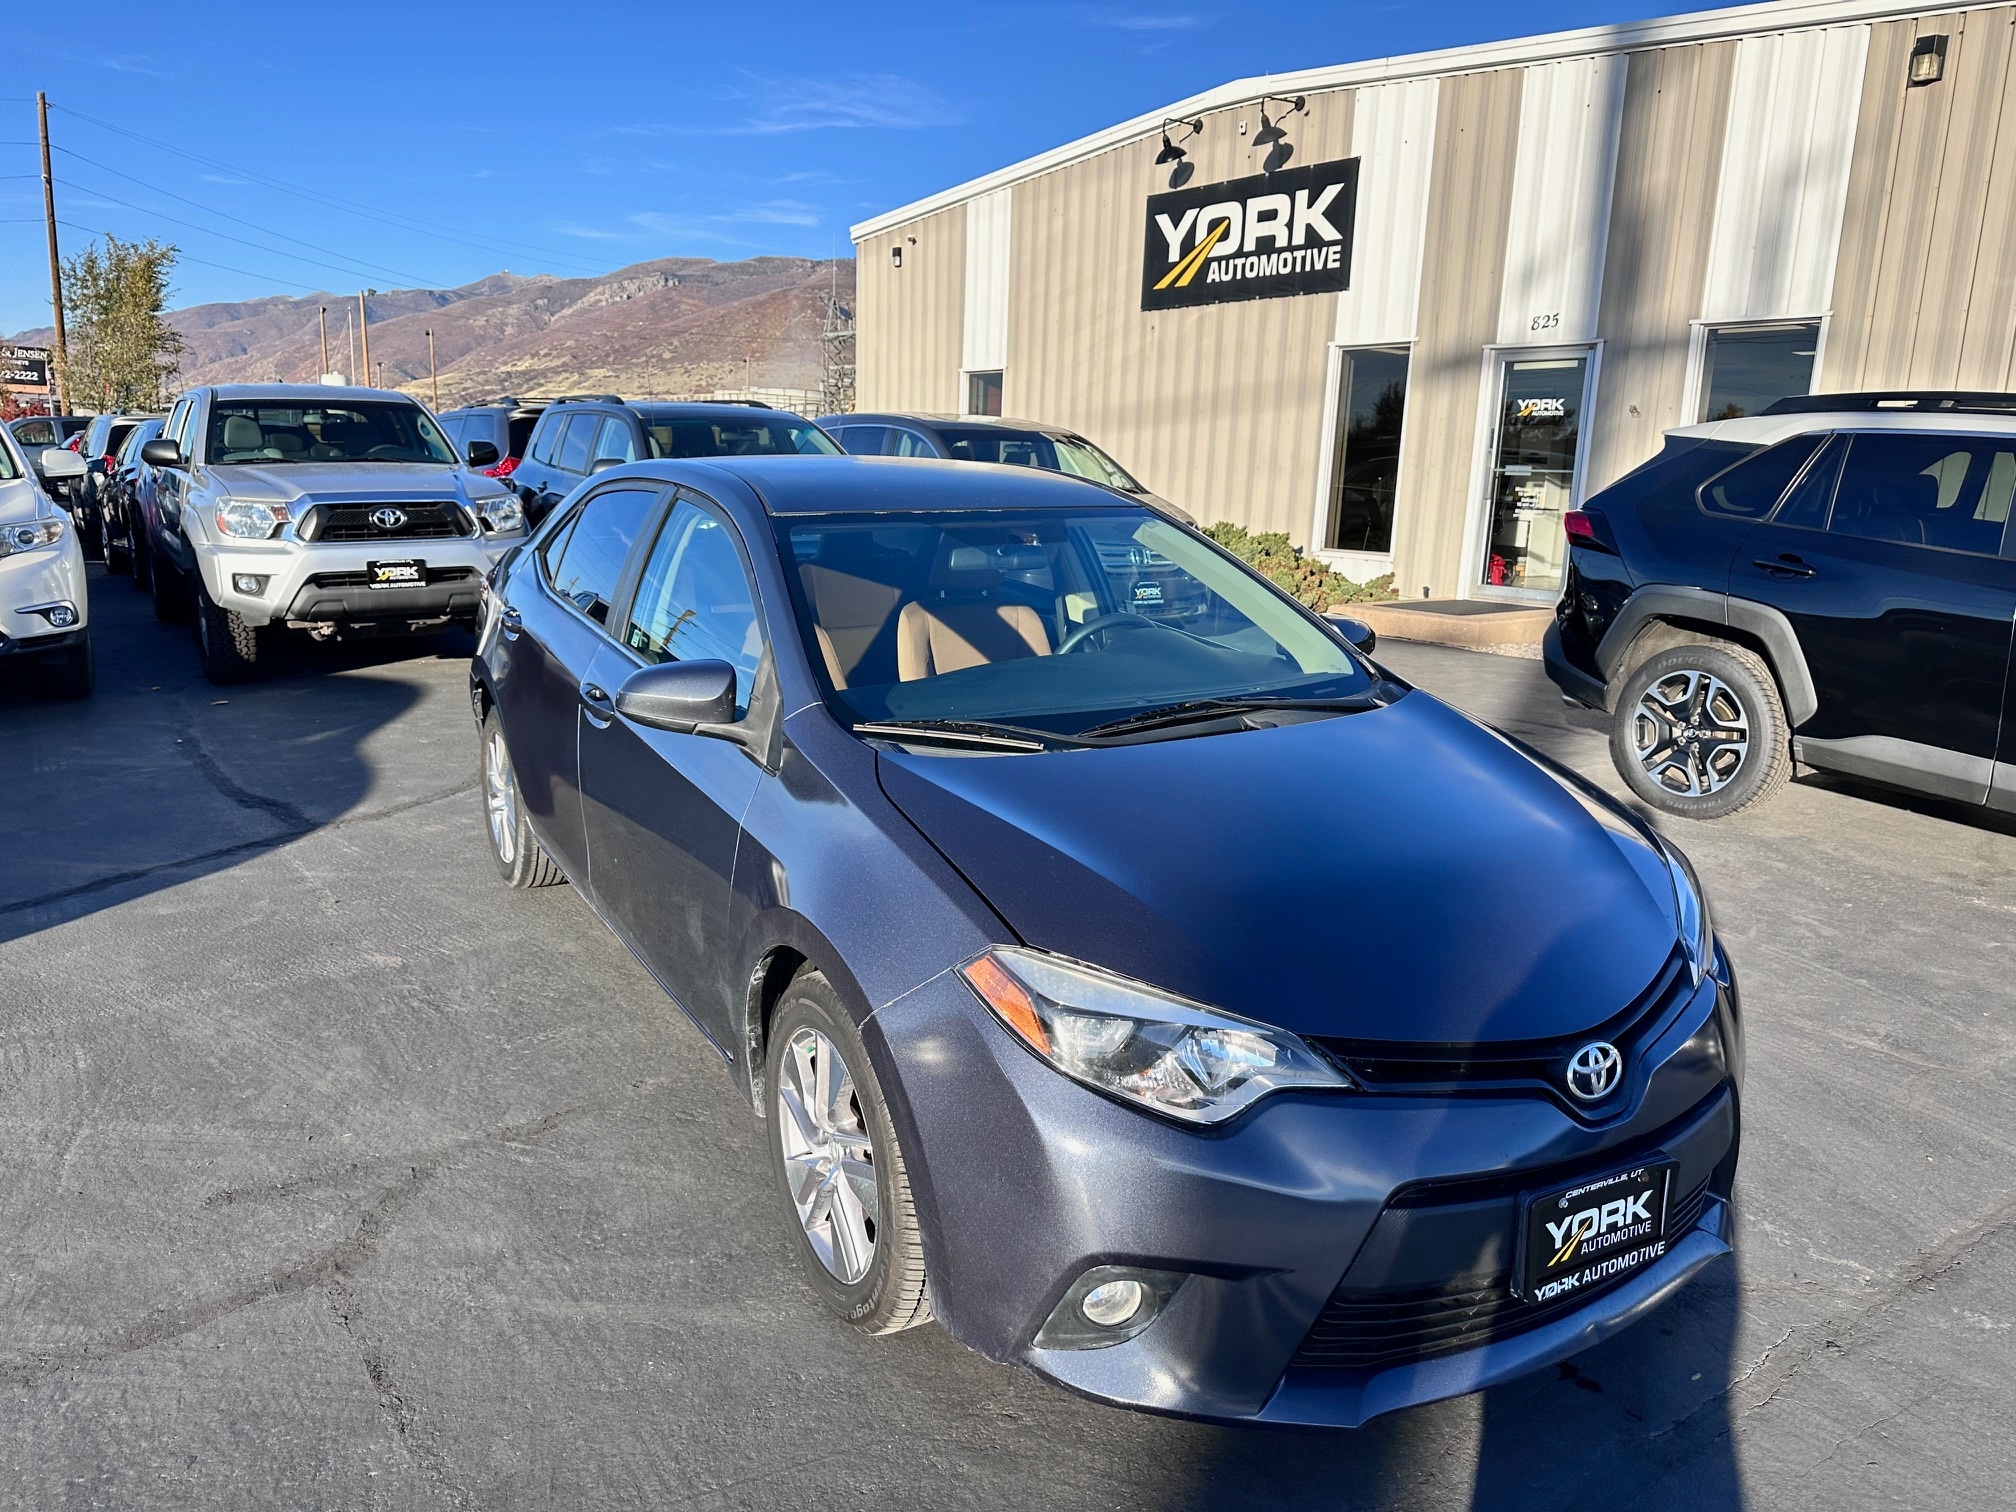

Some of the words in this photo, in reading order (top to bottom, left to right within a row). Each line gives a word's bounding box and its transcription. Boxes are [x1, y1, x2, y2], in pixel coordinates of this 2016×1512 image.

[1154, 183, 1345, 263] YORK
[1206, 245, 1342, 284] AUTOMOTIVE
[1531, 312, 1560, 331] 825
[1, 346, 12, 358] &
[13, 347, 47, 359] JENSEN
[1517, 398, 1565, 411] YORK
[374, 567, 418, 577] YORK
[1565, 1173, 1629, 1199] CENTERVILLE,
[1630, 1168, 1645, 1179] UT
[1545, 1189, 1653, 1250] YORK
[1580, 1220, 1652, 1255] AUTOMOTIVE
[1533, 1272, 1581, 1302] YORK
[1582, 1241, 1666, 1284] AUTOMOTIVE
